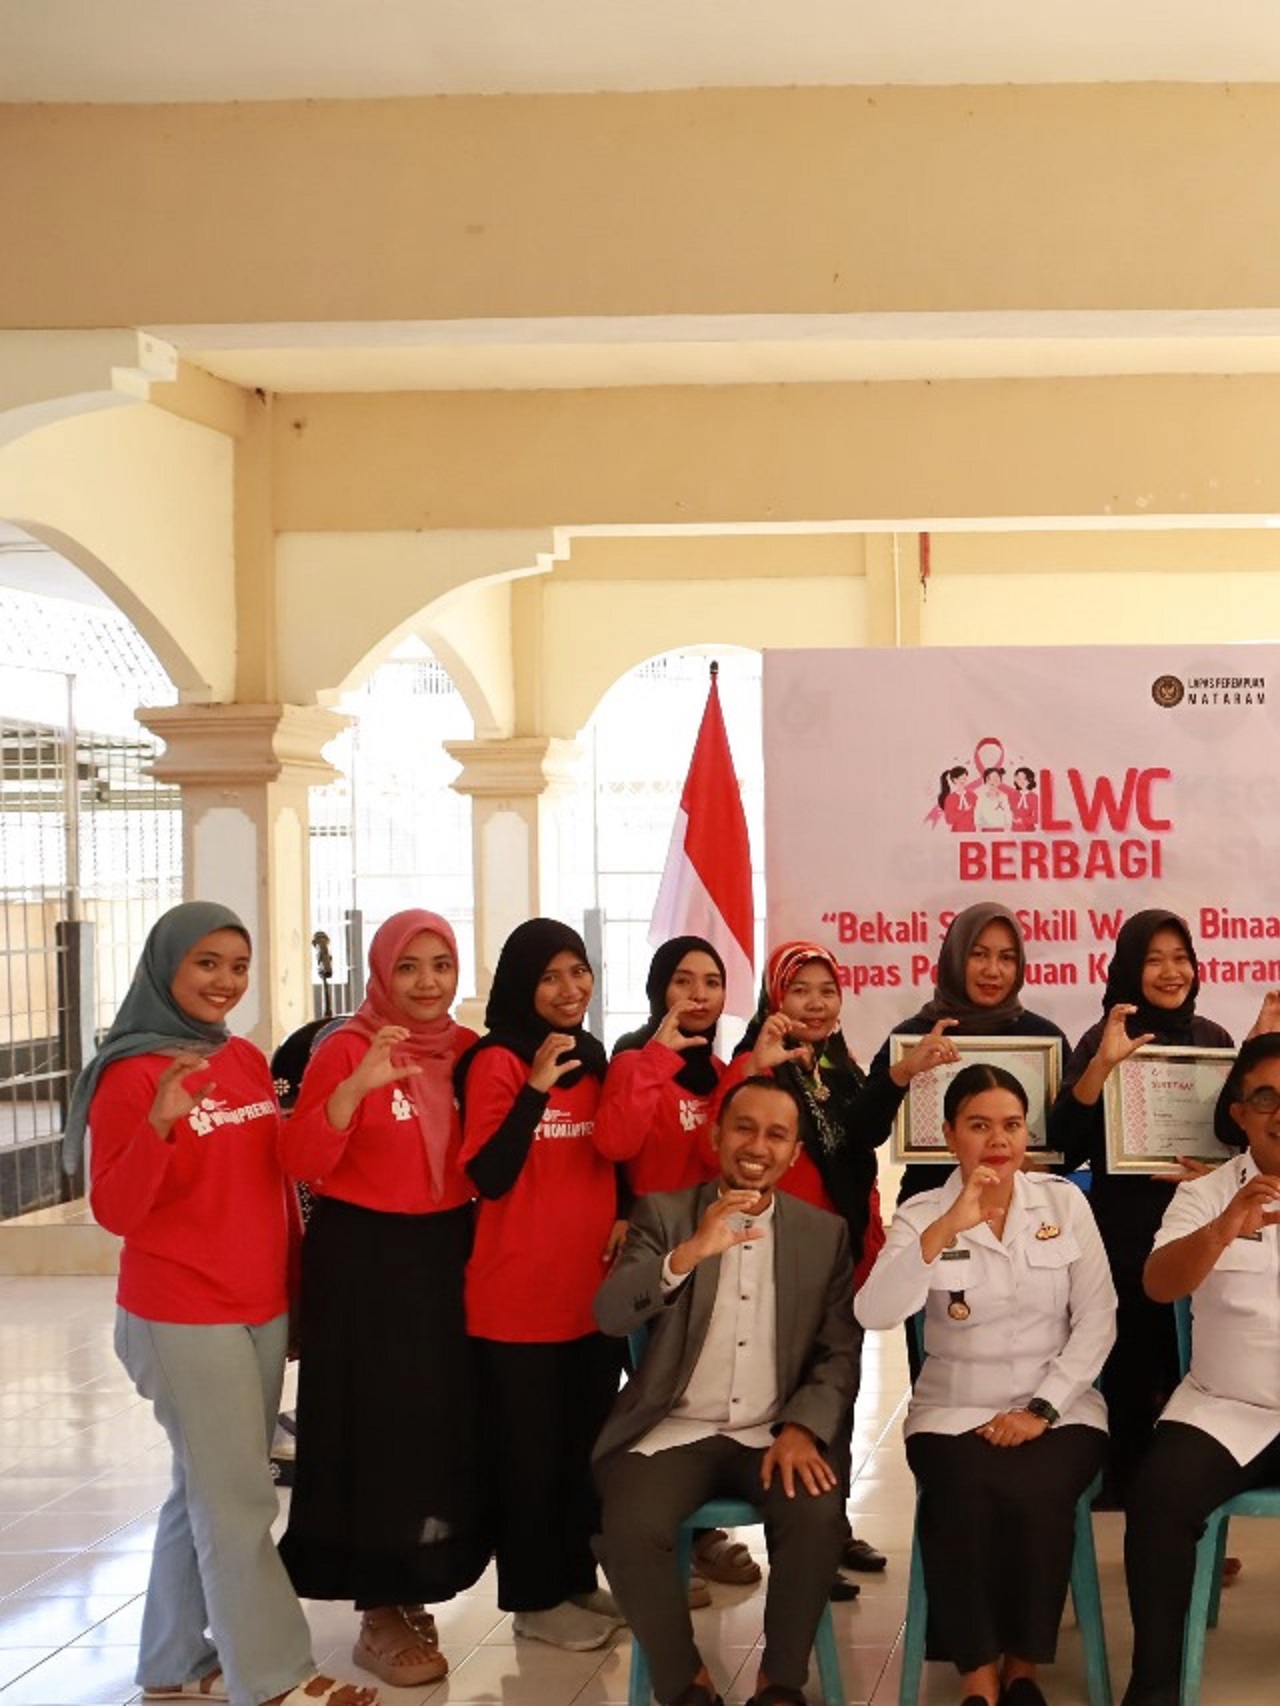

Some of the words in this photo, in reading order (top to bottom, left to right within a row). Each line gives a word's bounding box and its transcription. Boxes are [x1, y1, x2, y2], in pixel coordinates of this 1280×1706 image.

[1187, 693, 1265, 705] MATARAM
[1039, 767, 1172, 832] LWC
[959, 840, 1163, 881] BERBAGI
[838, 961, 902, 995] apas
